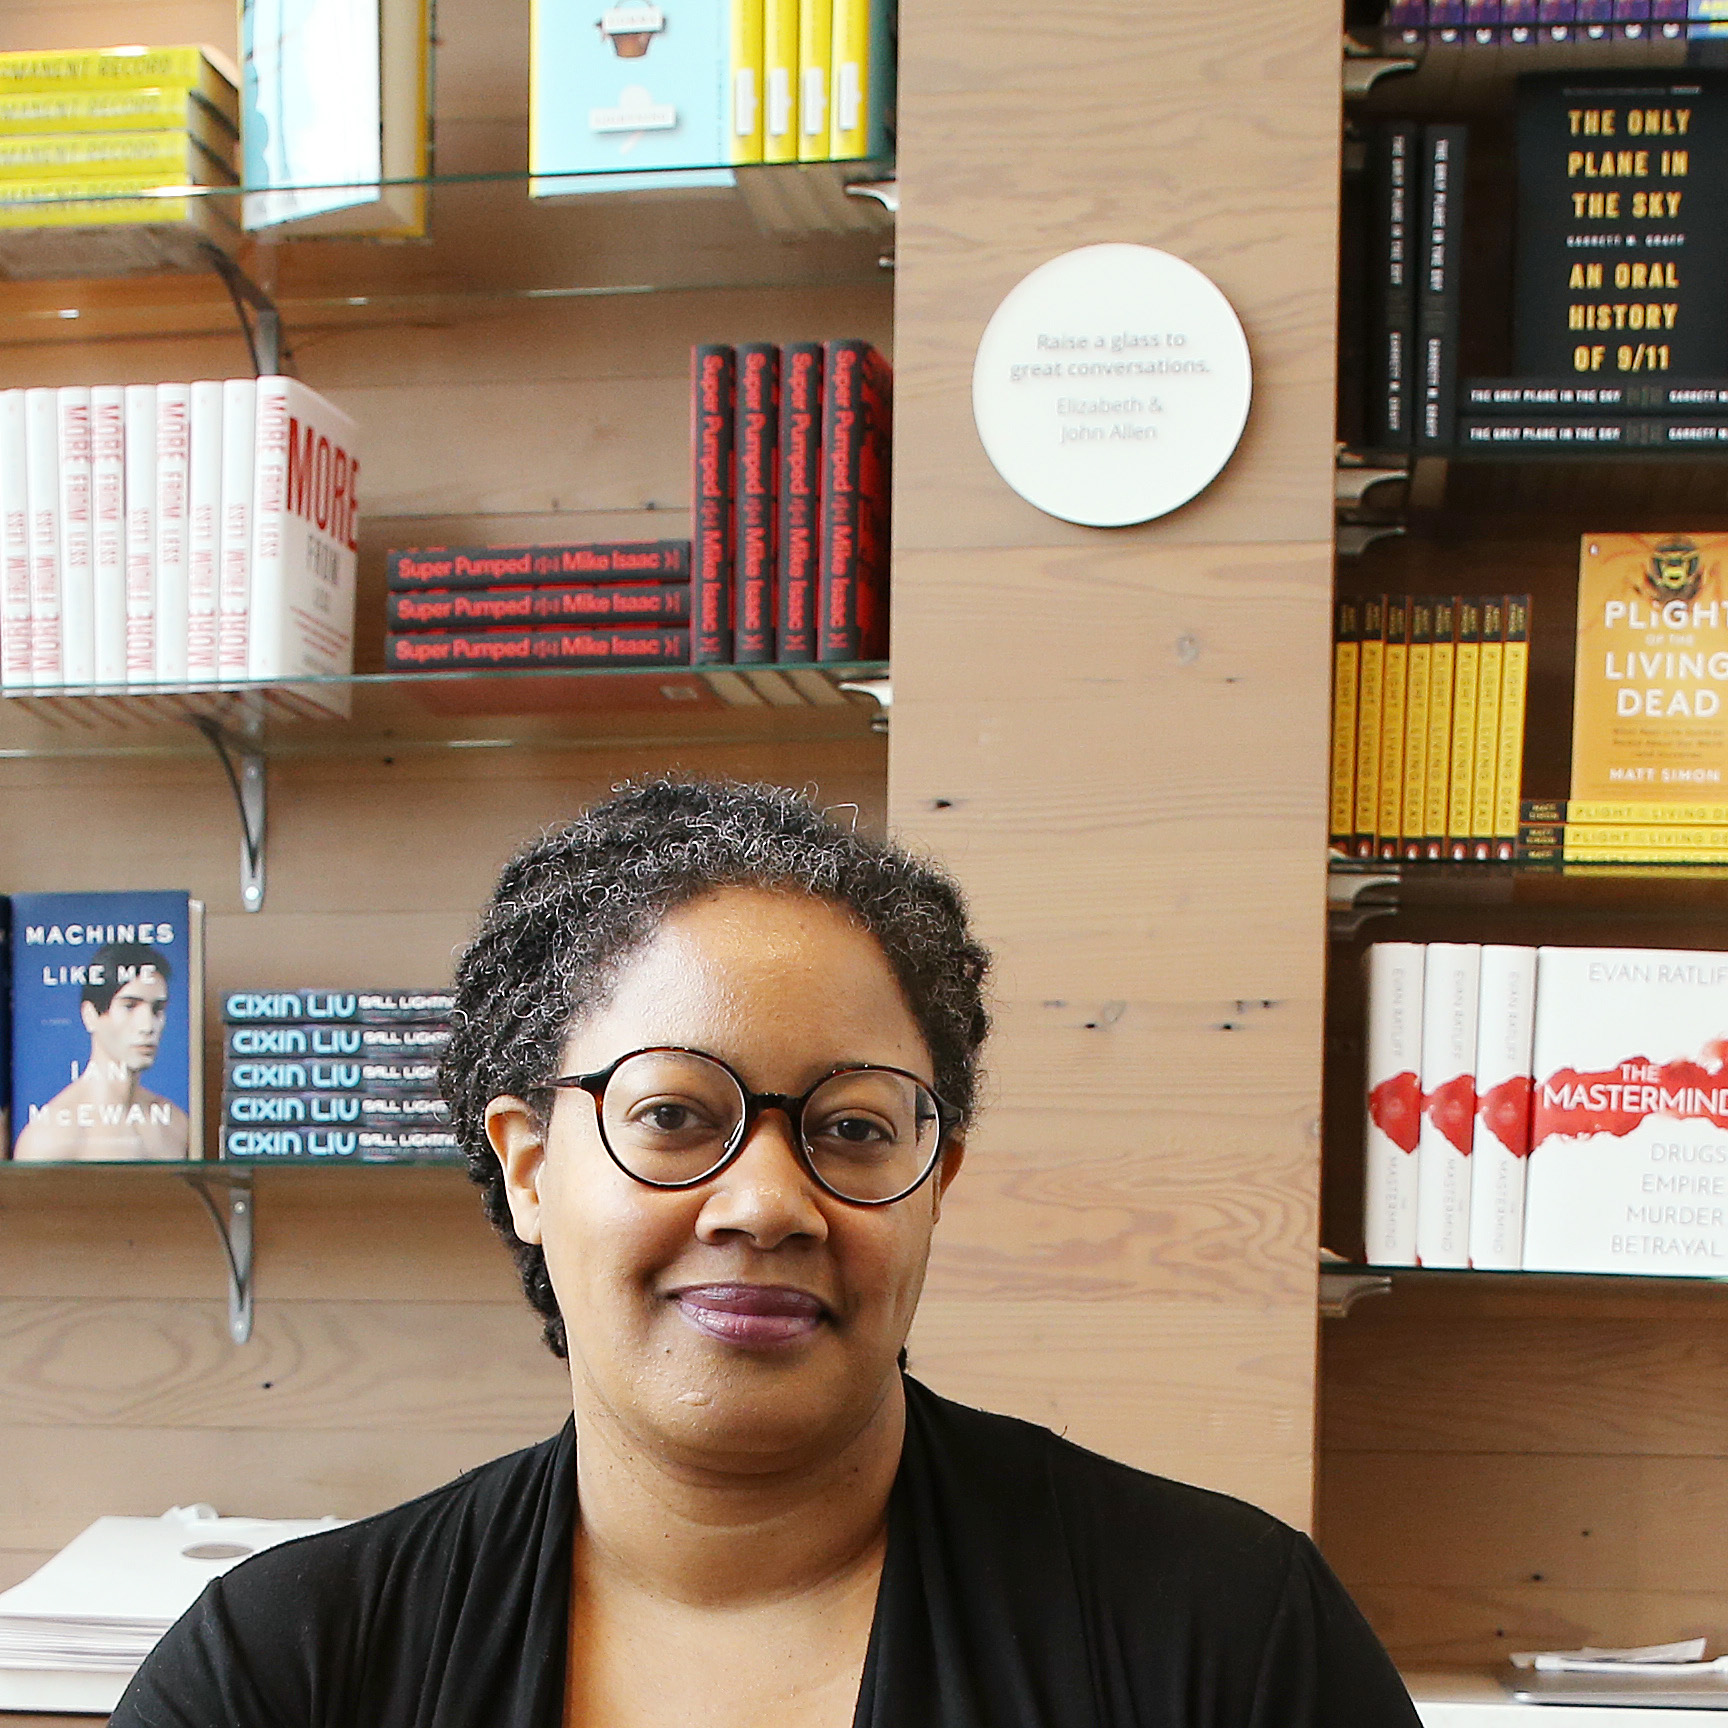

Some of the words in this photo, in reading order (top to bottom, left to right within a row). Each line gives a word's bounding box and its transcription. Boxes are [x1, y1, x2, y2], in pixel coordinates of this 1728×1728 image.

[1568, 109, 1616, 136] THE
[1627, 108, 1691, 136] ONLY
[1568, 150, 1649, 178] PLANE
[1661, 150, 1689, 177] IN
[1572, 191, 1620, 218] THE
[1632, 191, 1682, 218] SKY
[1569, 262, 1603, 289] AN
[1614, 262, 1680, 289] ORAL
[1568, 304, 1678, 330] HISTORY
[1037, 334, 1089, 350] Raise
[1095, 337, 1104, 348] a
[1111, 333, 1159, 351] glass
[1166, 334, 1185, 346] to
[1574, 344, 1606, 372] OF
[1617, 343, 1670, 372] 9/11
[1010, 363, 1061, 381] great
[1068, 359, 1210, 376] conversations.
[1057, 397, 1142, 414] Elizabeth
[1149, 398, 1162, 413] &
[1060, 425, 1103, 444] John
[1110, 424, 1157, 440] Allen
[398, 558, 452, 581] Super
[454, 554, 532, 578] Pumped
[562, 551, 610, 571] Mike
[612, 550, 660, 570] Isaac
[1616, 688, 1720, 718] DEAD
[1610, 768, 1654, 781] MATT
[1662, 768, 1720, 782] SIMON
[25, 924, 175, 946] MACHINES
[43, 965, 106, 986] LIKE
[118, 965, 157, 985] ME
[1588, 961, 1653, 984] EVAN
[227, 994, 302, 1018] CIXIN
[306, 994, 357, 1018] LIU
[71, 1061, 129, 1082] IAN
[1620, 1064, 1661, 1083] THE
[29, 1105, 172, 1127] McEWAN
[1650, 1142, 1728, 1164] DRUGS
[1641, 1174, 1726, 1196] EMPIRE
[1626, 1205, 1724, 1227] MURDER
[1611, 1234, 1723, 1258] BETRAYAL
